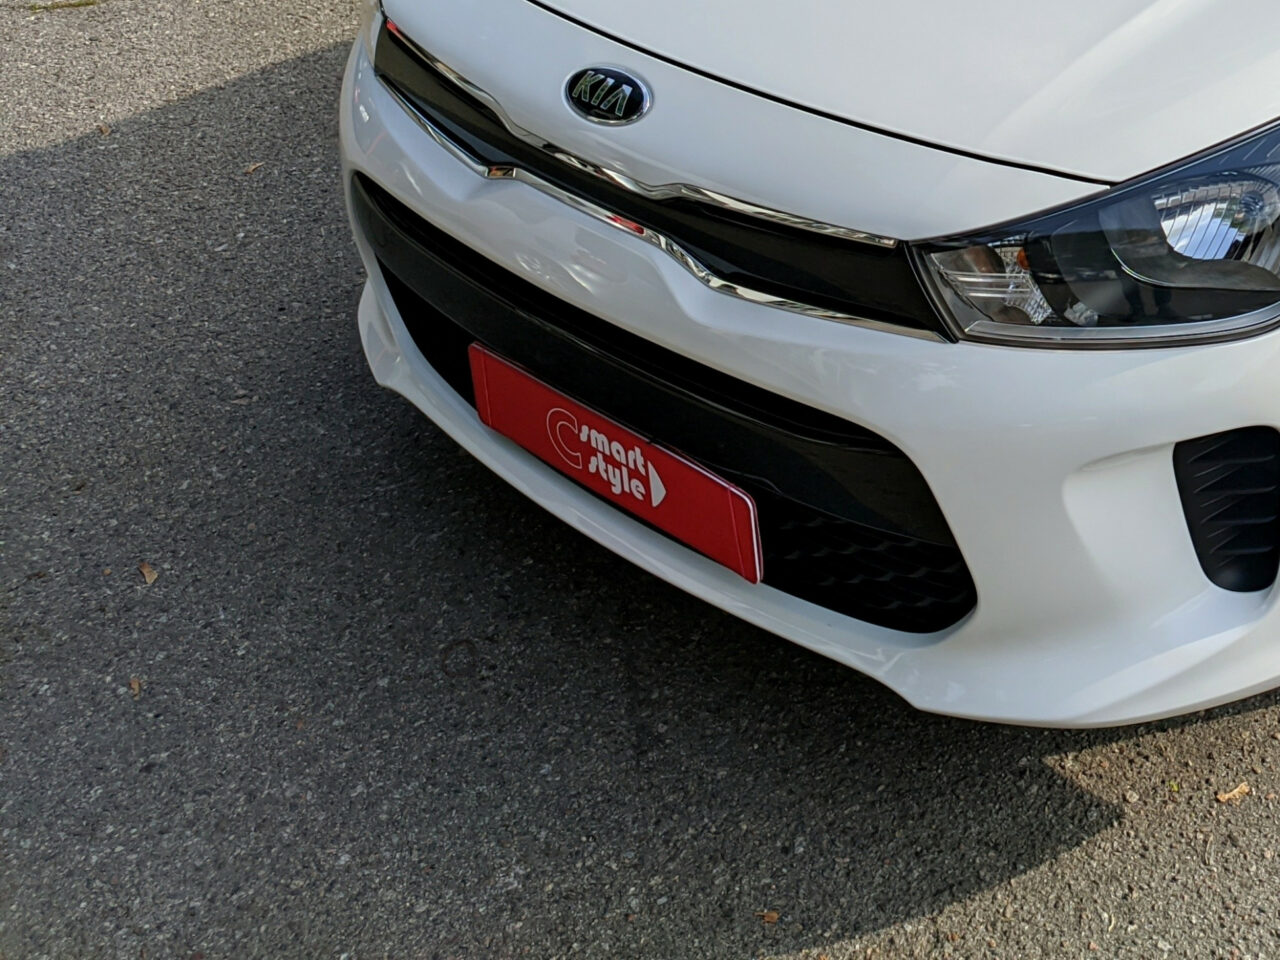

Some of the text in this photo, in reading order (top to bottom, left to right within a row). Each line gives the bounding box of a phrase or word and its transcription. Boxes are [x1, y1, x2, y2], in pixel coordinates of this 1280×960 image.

[571, 70, 633, 117] KIA
[579, 424, 646, 476] smart
[588, 453, 647, 501] style
